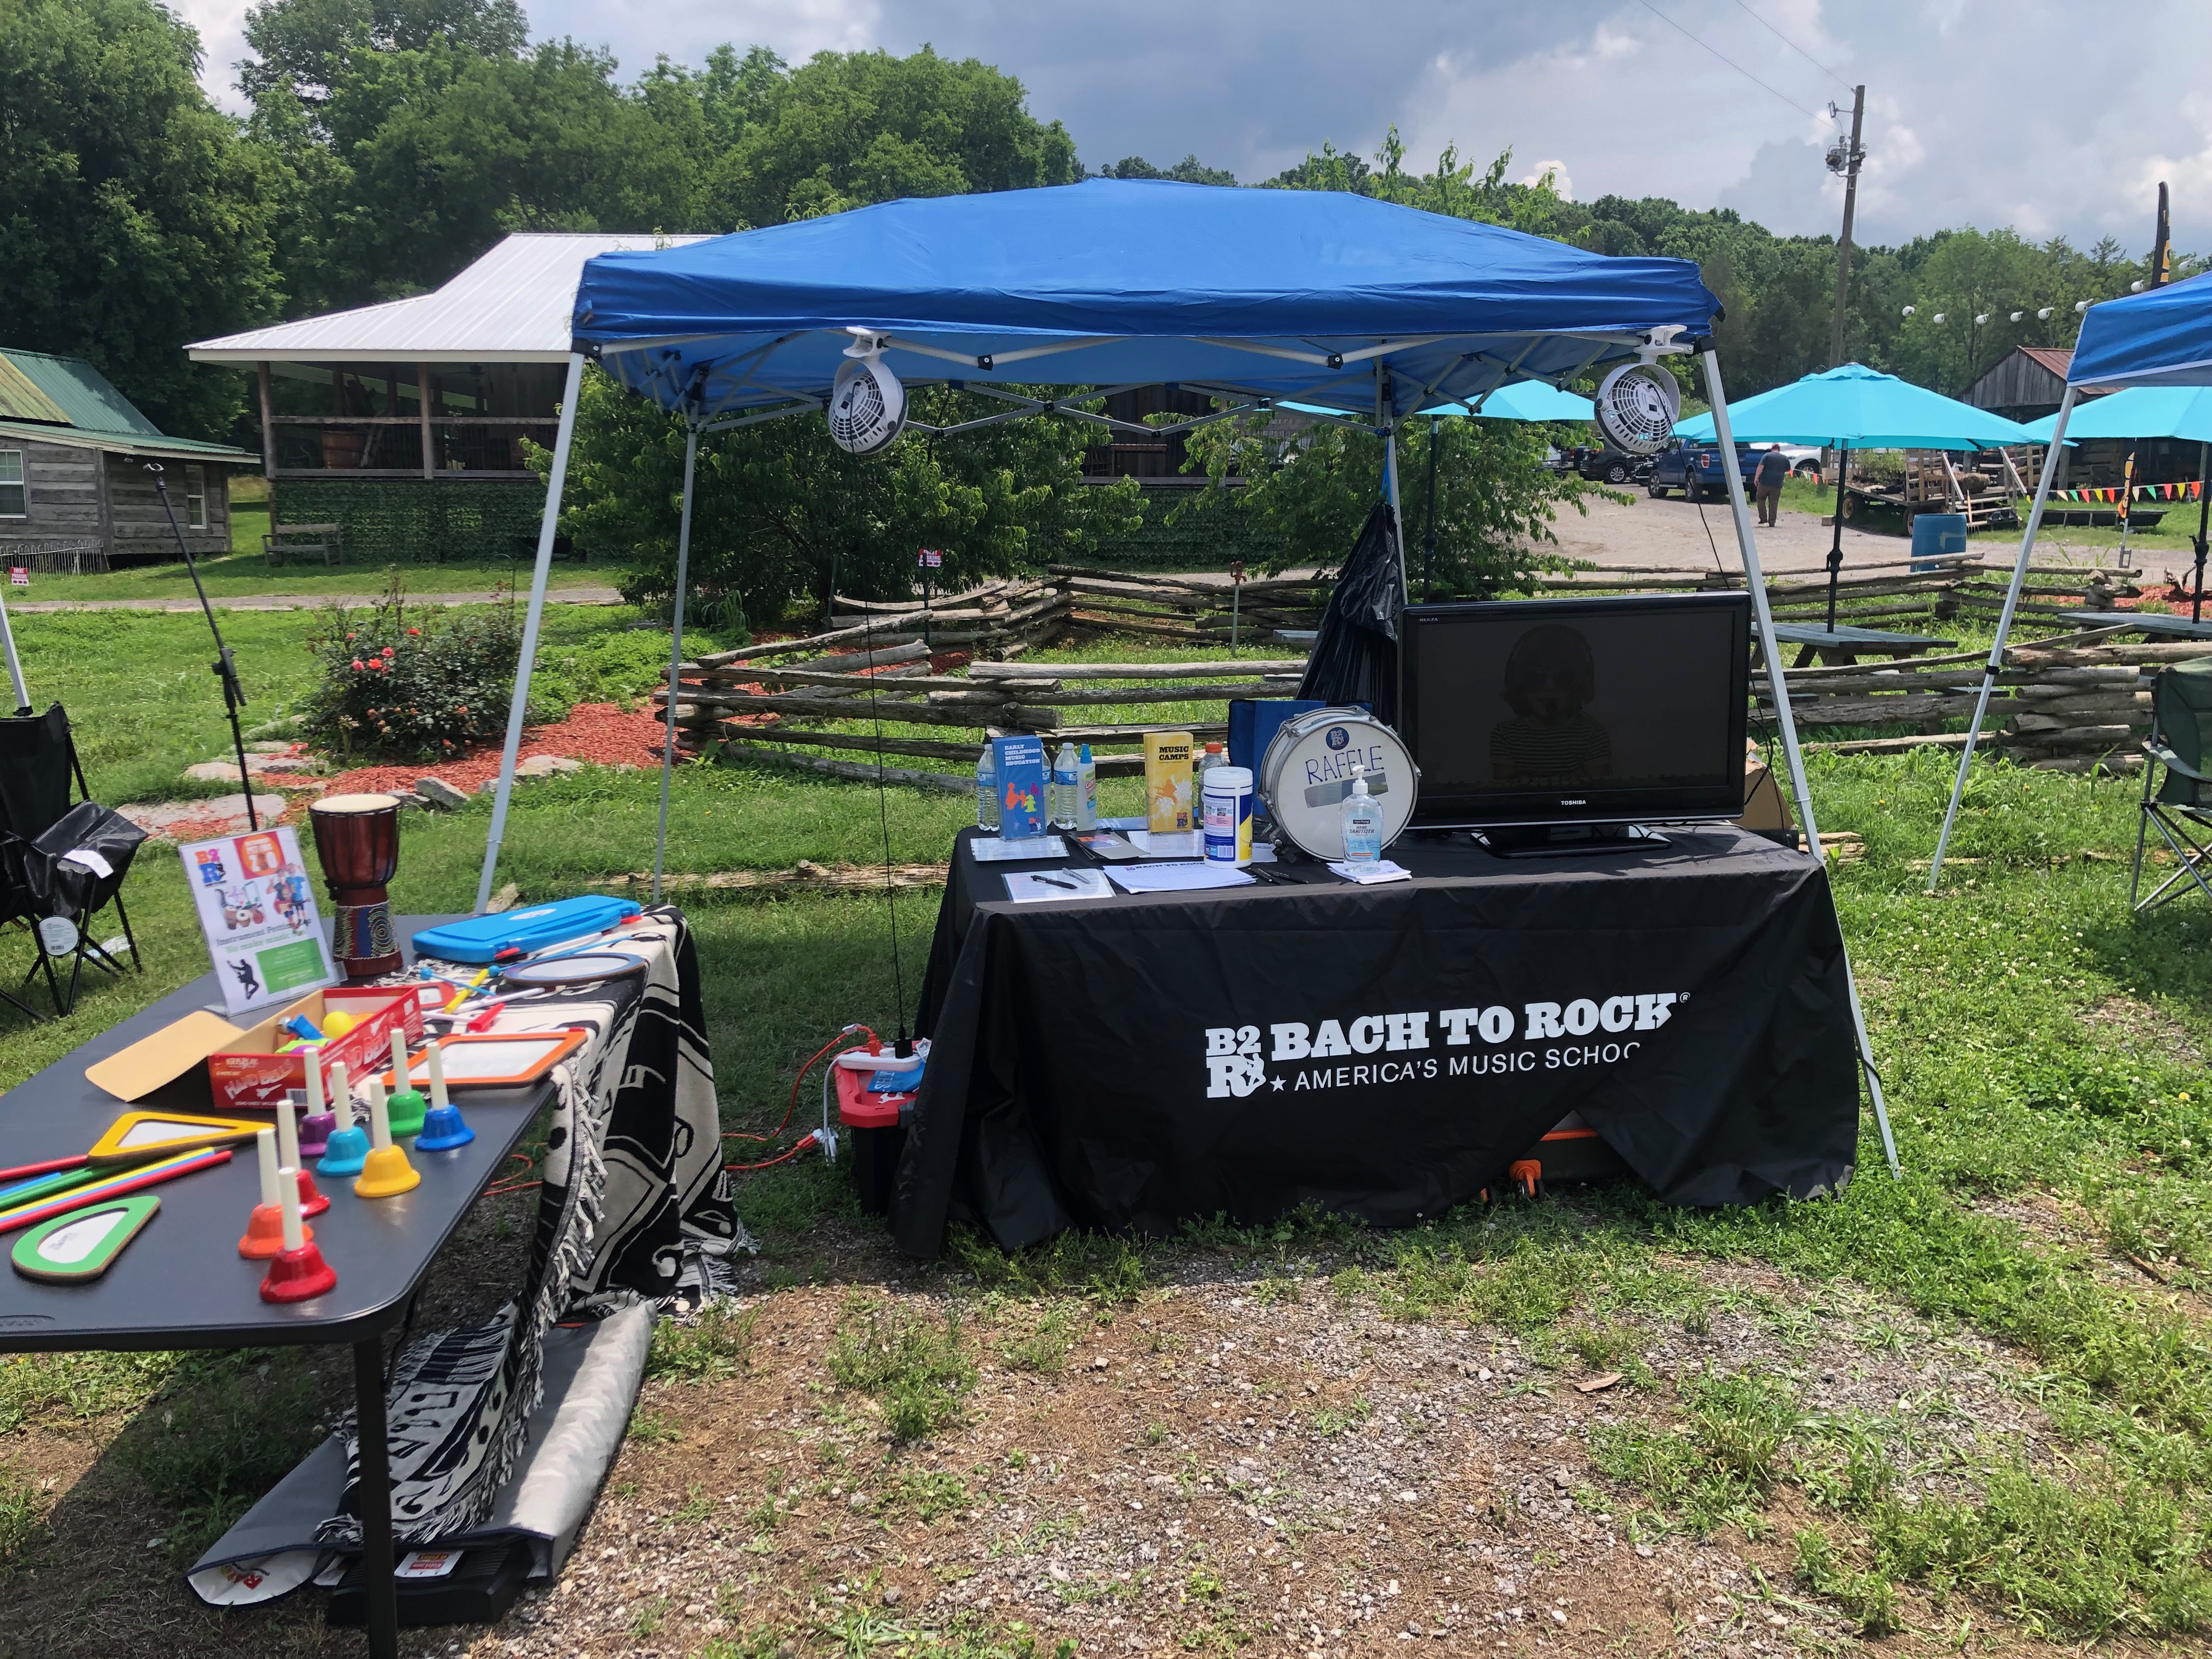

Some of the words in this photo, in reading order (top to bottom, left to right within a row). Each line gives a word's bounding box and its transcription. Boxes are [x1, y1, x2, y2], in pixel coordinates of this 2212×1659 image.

[1005, 758, 1041, 766] EDUCATION
[1305, 745, 1385, 785] RAFFLE
[1205, 1025, 1262, 1057] B2
[1270, 1011, 1430, 1061] BACH
[1440, 1004, 1515, 1045] TO
[1524, 992, 1678, 1040] ROCK
[1294, 1058, 1438, 1092] AMERICA'S
[1449, 1051, 1536, 1076] MUSIC
